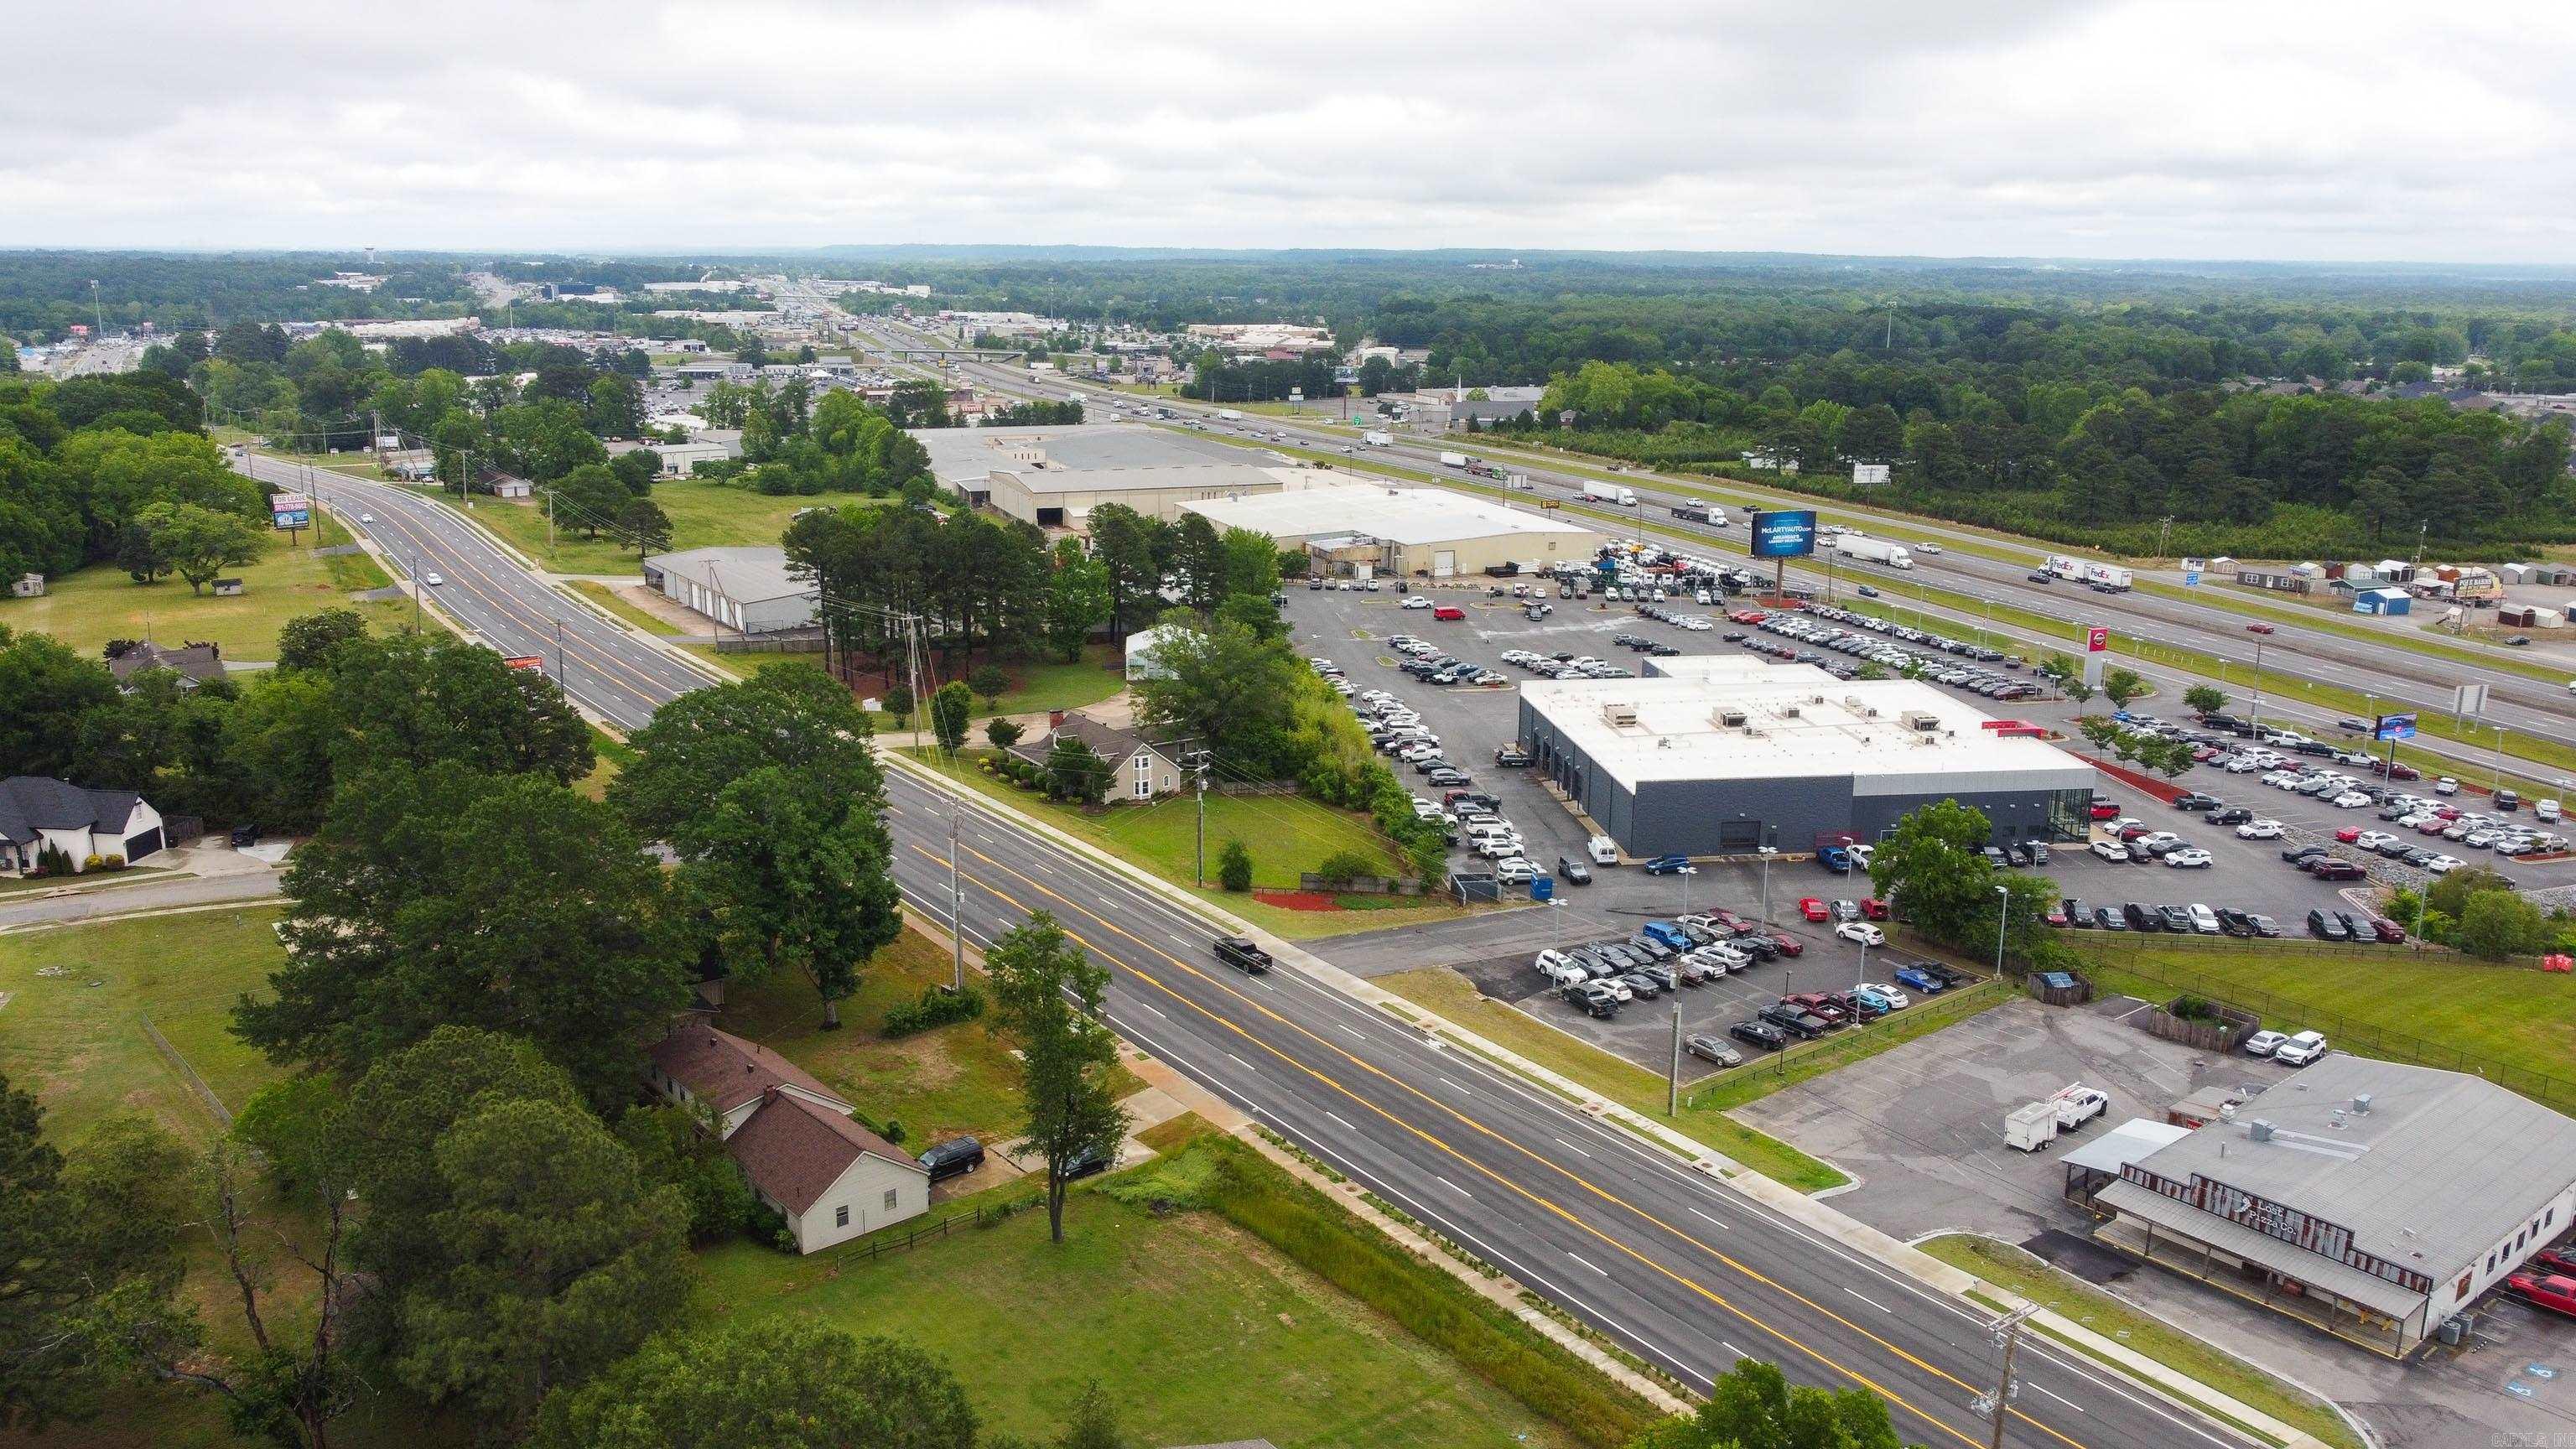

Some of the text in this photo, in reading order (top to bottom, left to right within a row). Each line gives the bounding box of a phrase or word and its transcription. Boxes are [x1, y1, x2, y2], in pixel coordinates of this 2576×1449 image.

[2053, 558, 2074, 571] FedEx
[2090, 568, 2111, 579] FedEx
[2257, 1200, 2284, 1217] Lost
[2250, 1210, 2297, 1235] Pizza Co.
